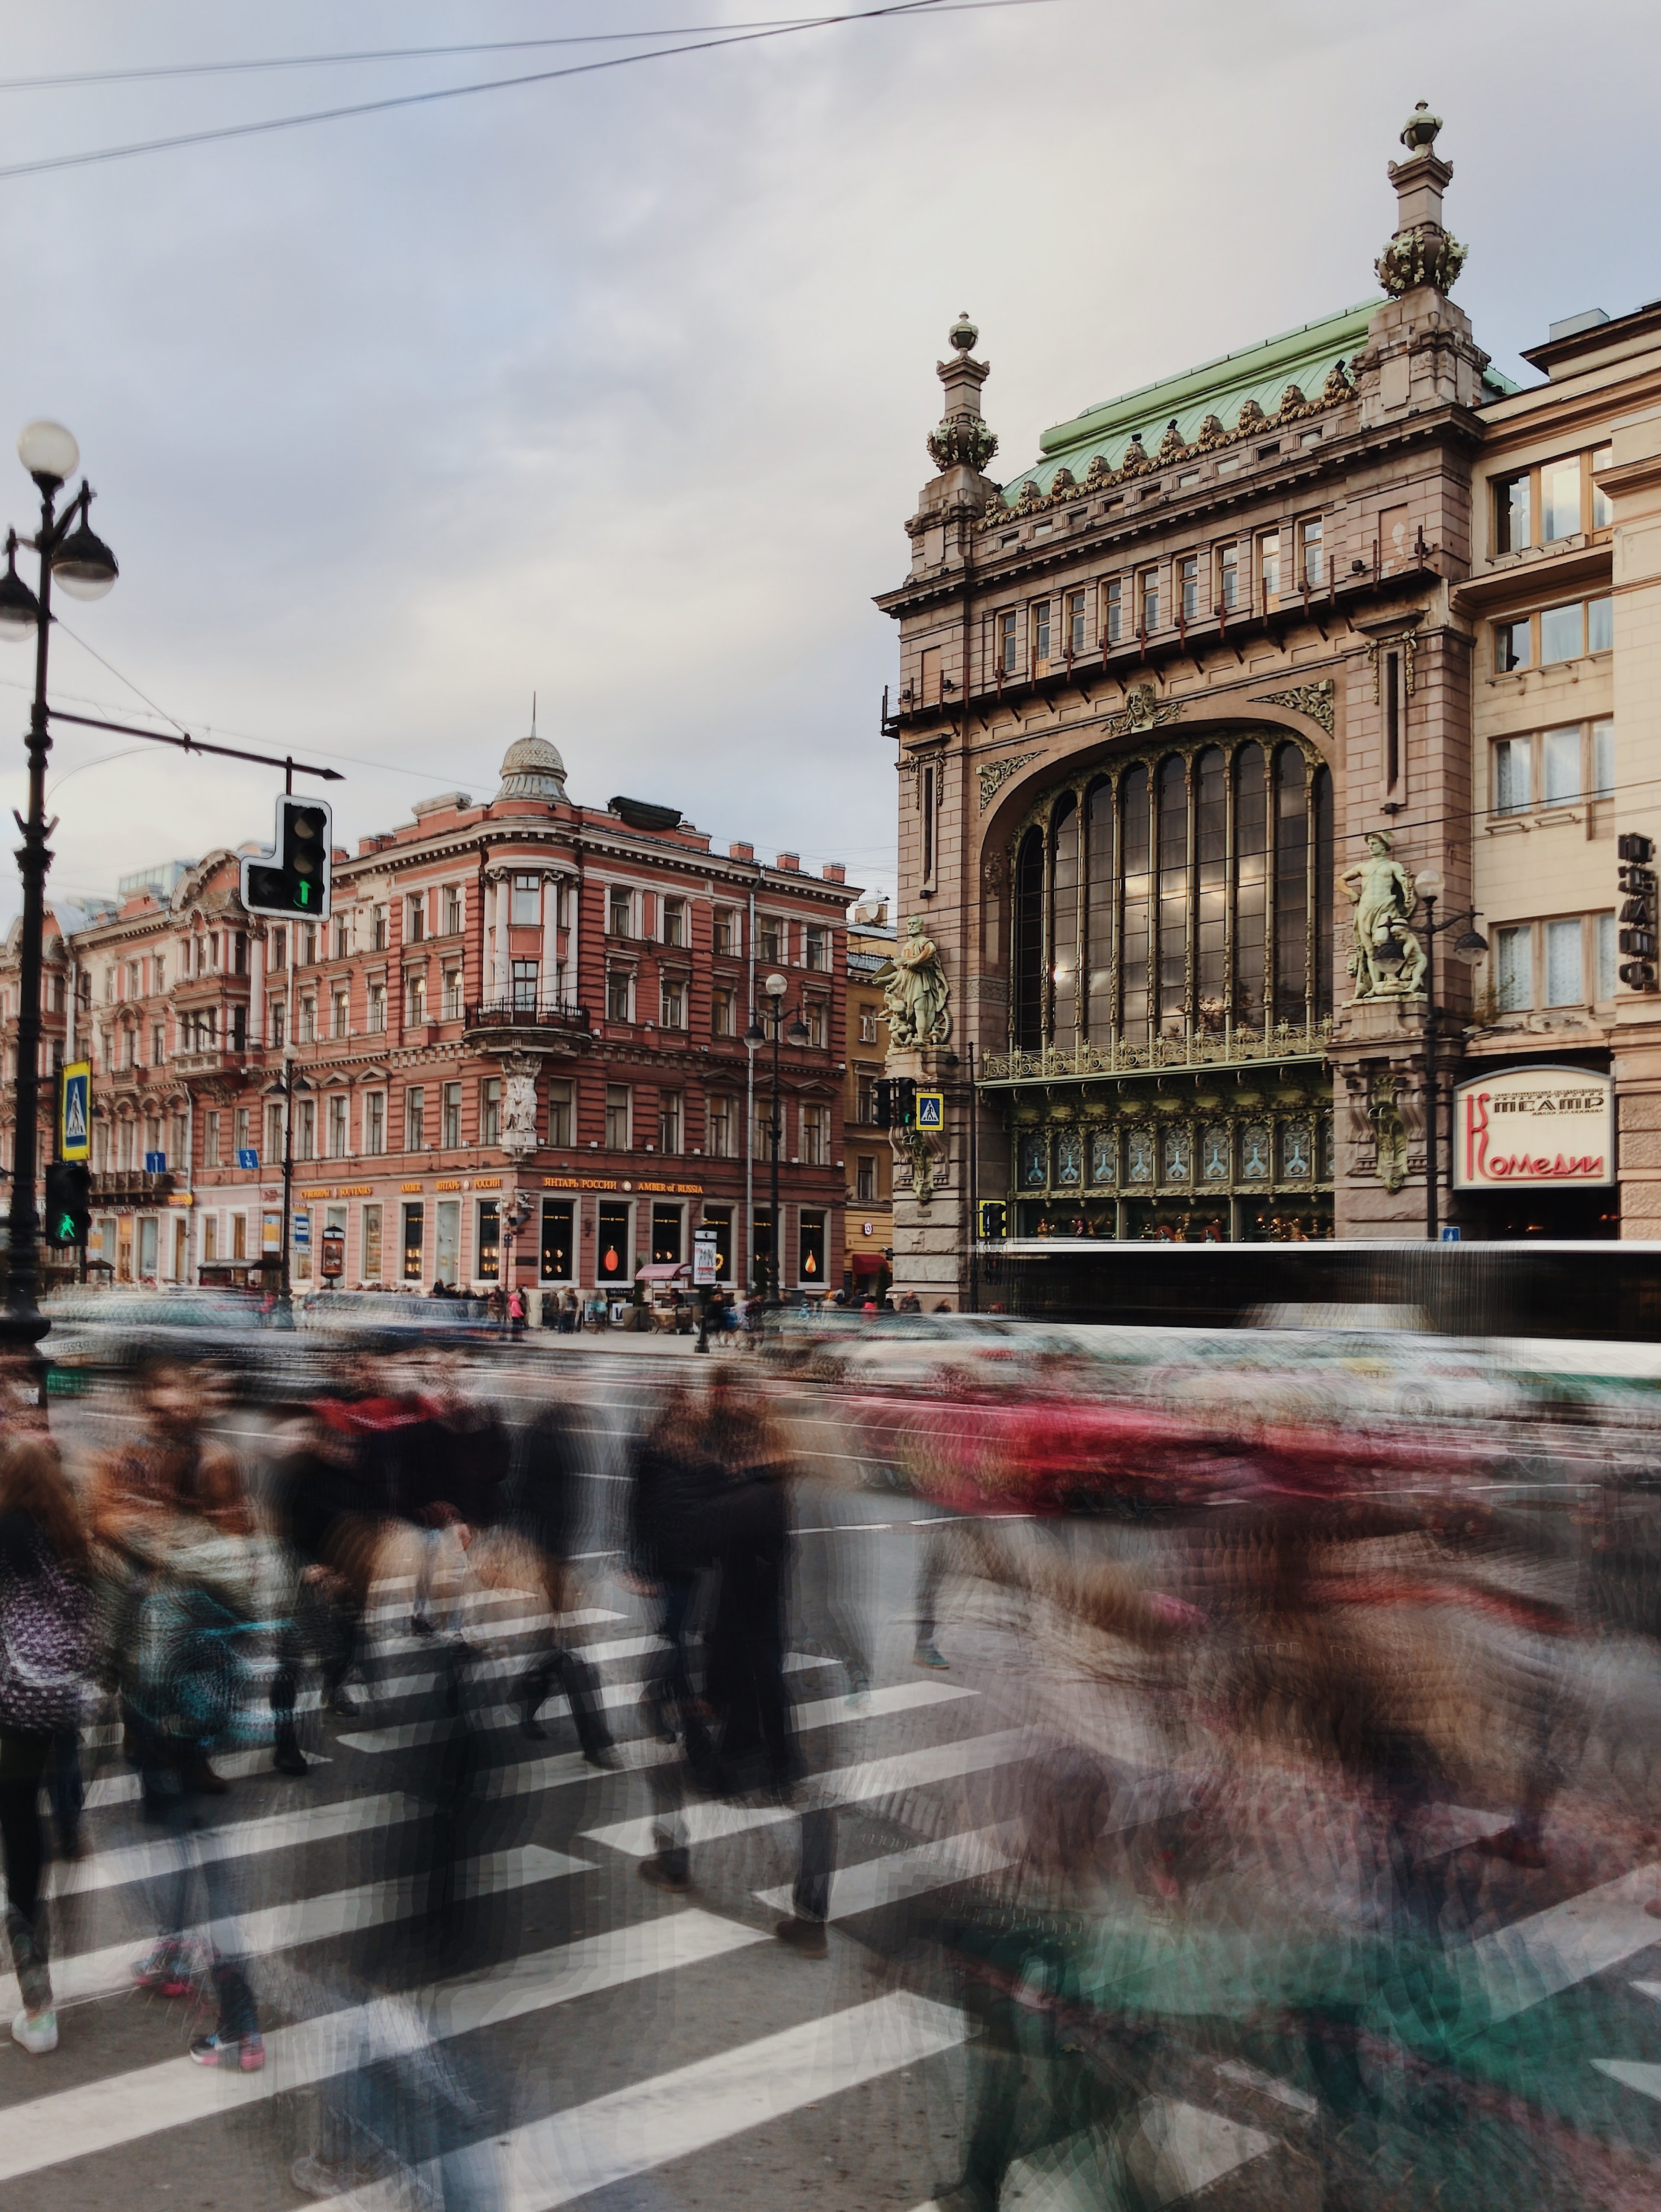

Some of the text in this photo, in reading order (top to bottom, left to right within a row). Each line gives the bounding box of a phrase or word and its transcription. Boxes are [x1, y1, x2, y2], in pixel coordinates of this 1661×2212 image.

[435, 1178, 502, 1190] ЯНТАРЬ РОССИИ
[544, 1178, 617, 1189] ЯНТАРЬ РОССИИ
[638, 1182, 666, 1191] AMBER
[677, 1185, 704, 1194] RUSSIA
